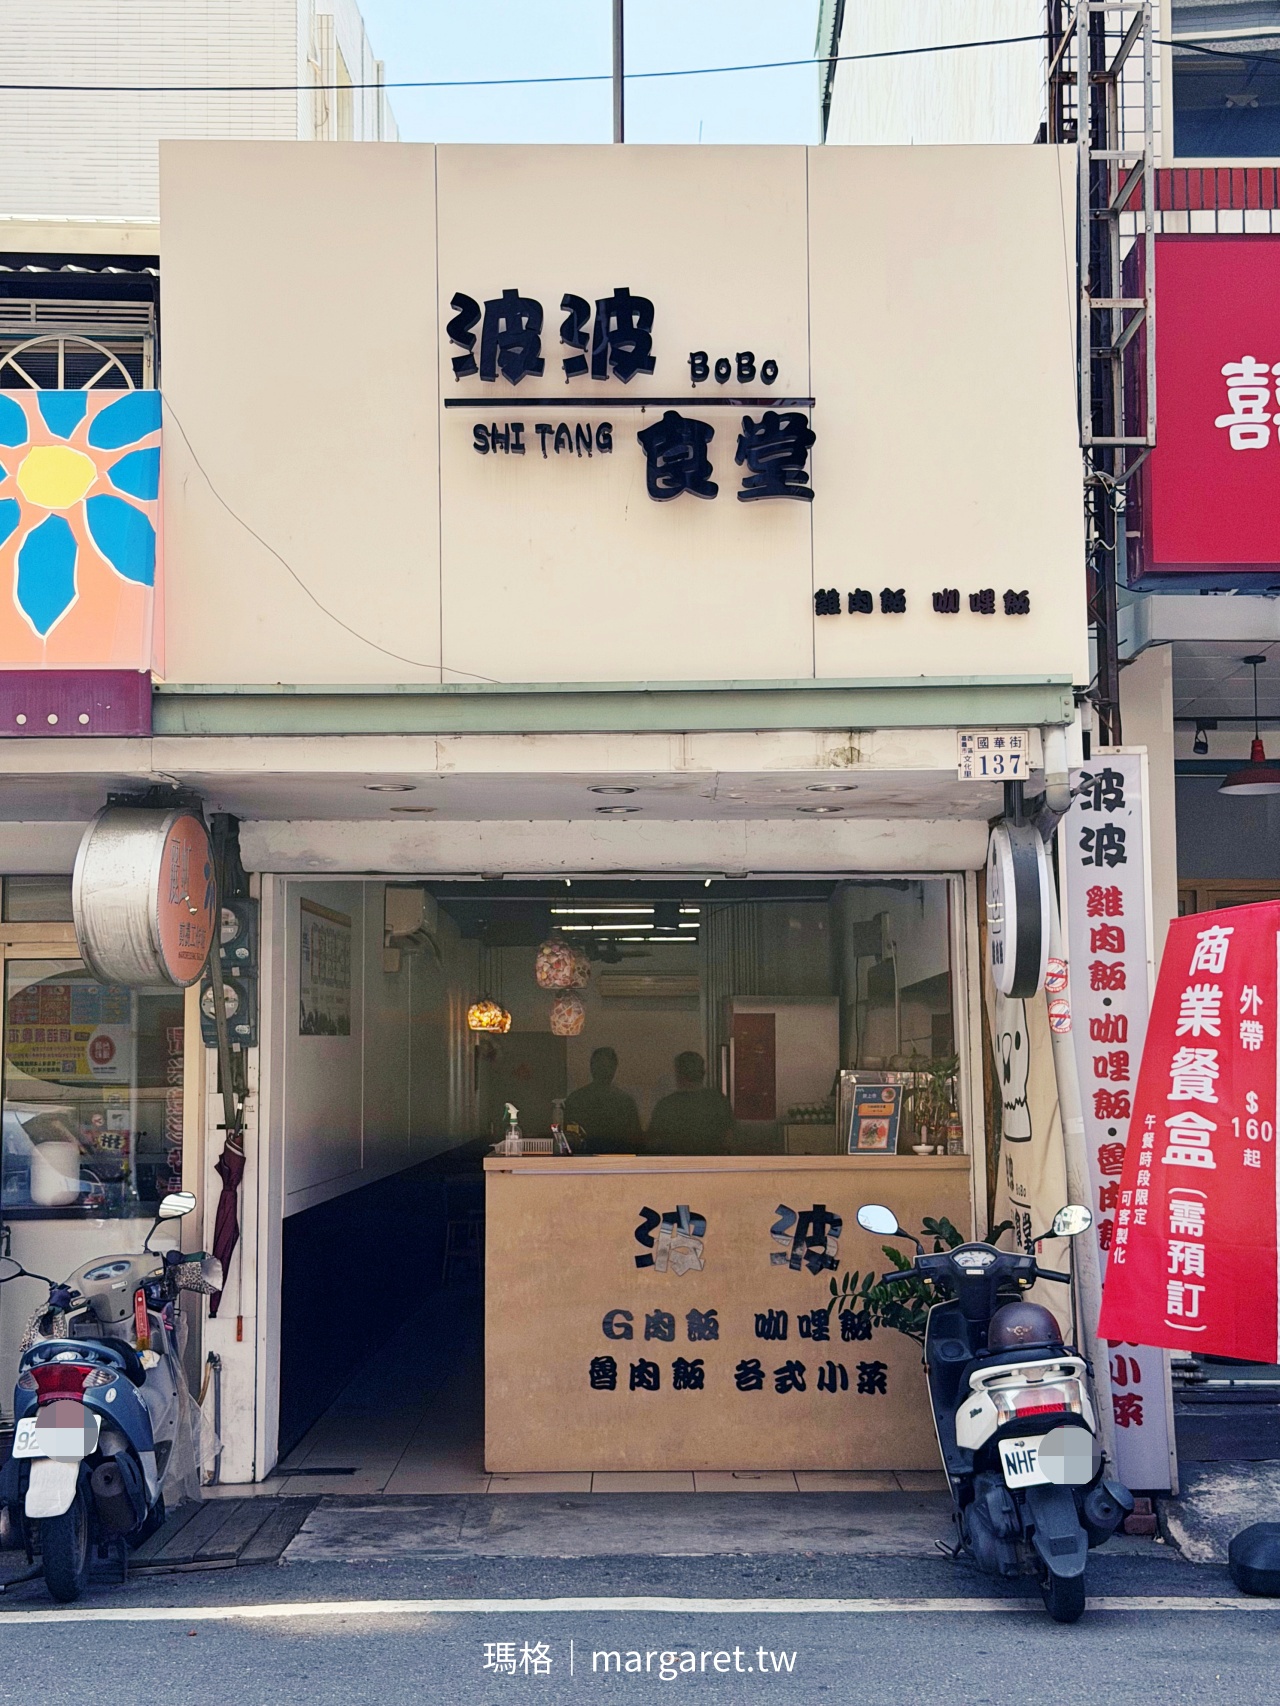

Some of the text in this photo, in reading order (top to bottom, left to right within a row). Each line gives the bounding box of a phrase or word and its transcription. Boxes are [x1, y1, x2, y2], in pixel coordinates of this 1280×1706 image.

[446, 287, 657, 387] 波波
[472, 421, 613, 457] SHI TANG
[636, 410, 817, 503] 食堂
[932, 587, 1030, 616] 咖哩飯
[977, 736, 1022, 750] 國華街
[963, 755, 973, 778] 文化里
[979, 754, 1021, 776] 137
[1079, 767, 1127, 869] 波波
[1239, 984, 1264, 1052] 外帶
[1161, 924, 1235, 1169] 商業餐盒
[1133, 1113, 1157, 1226] 午餐時段限定
[1113, 1190, 1131, 1265] 可客製化
[602, 1308, 873, 1342] G肉飯 咖哩飯
[588, 1355, 888, 1395] 魯肉飯 各式小菜
[1004, 1448, 1037, 1476] NHF
